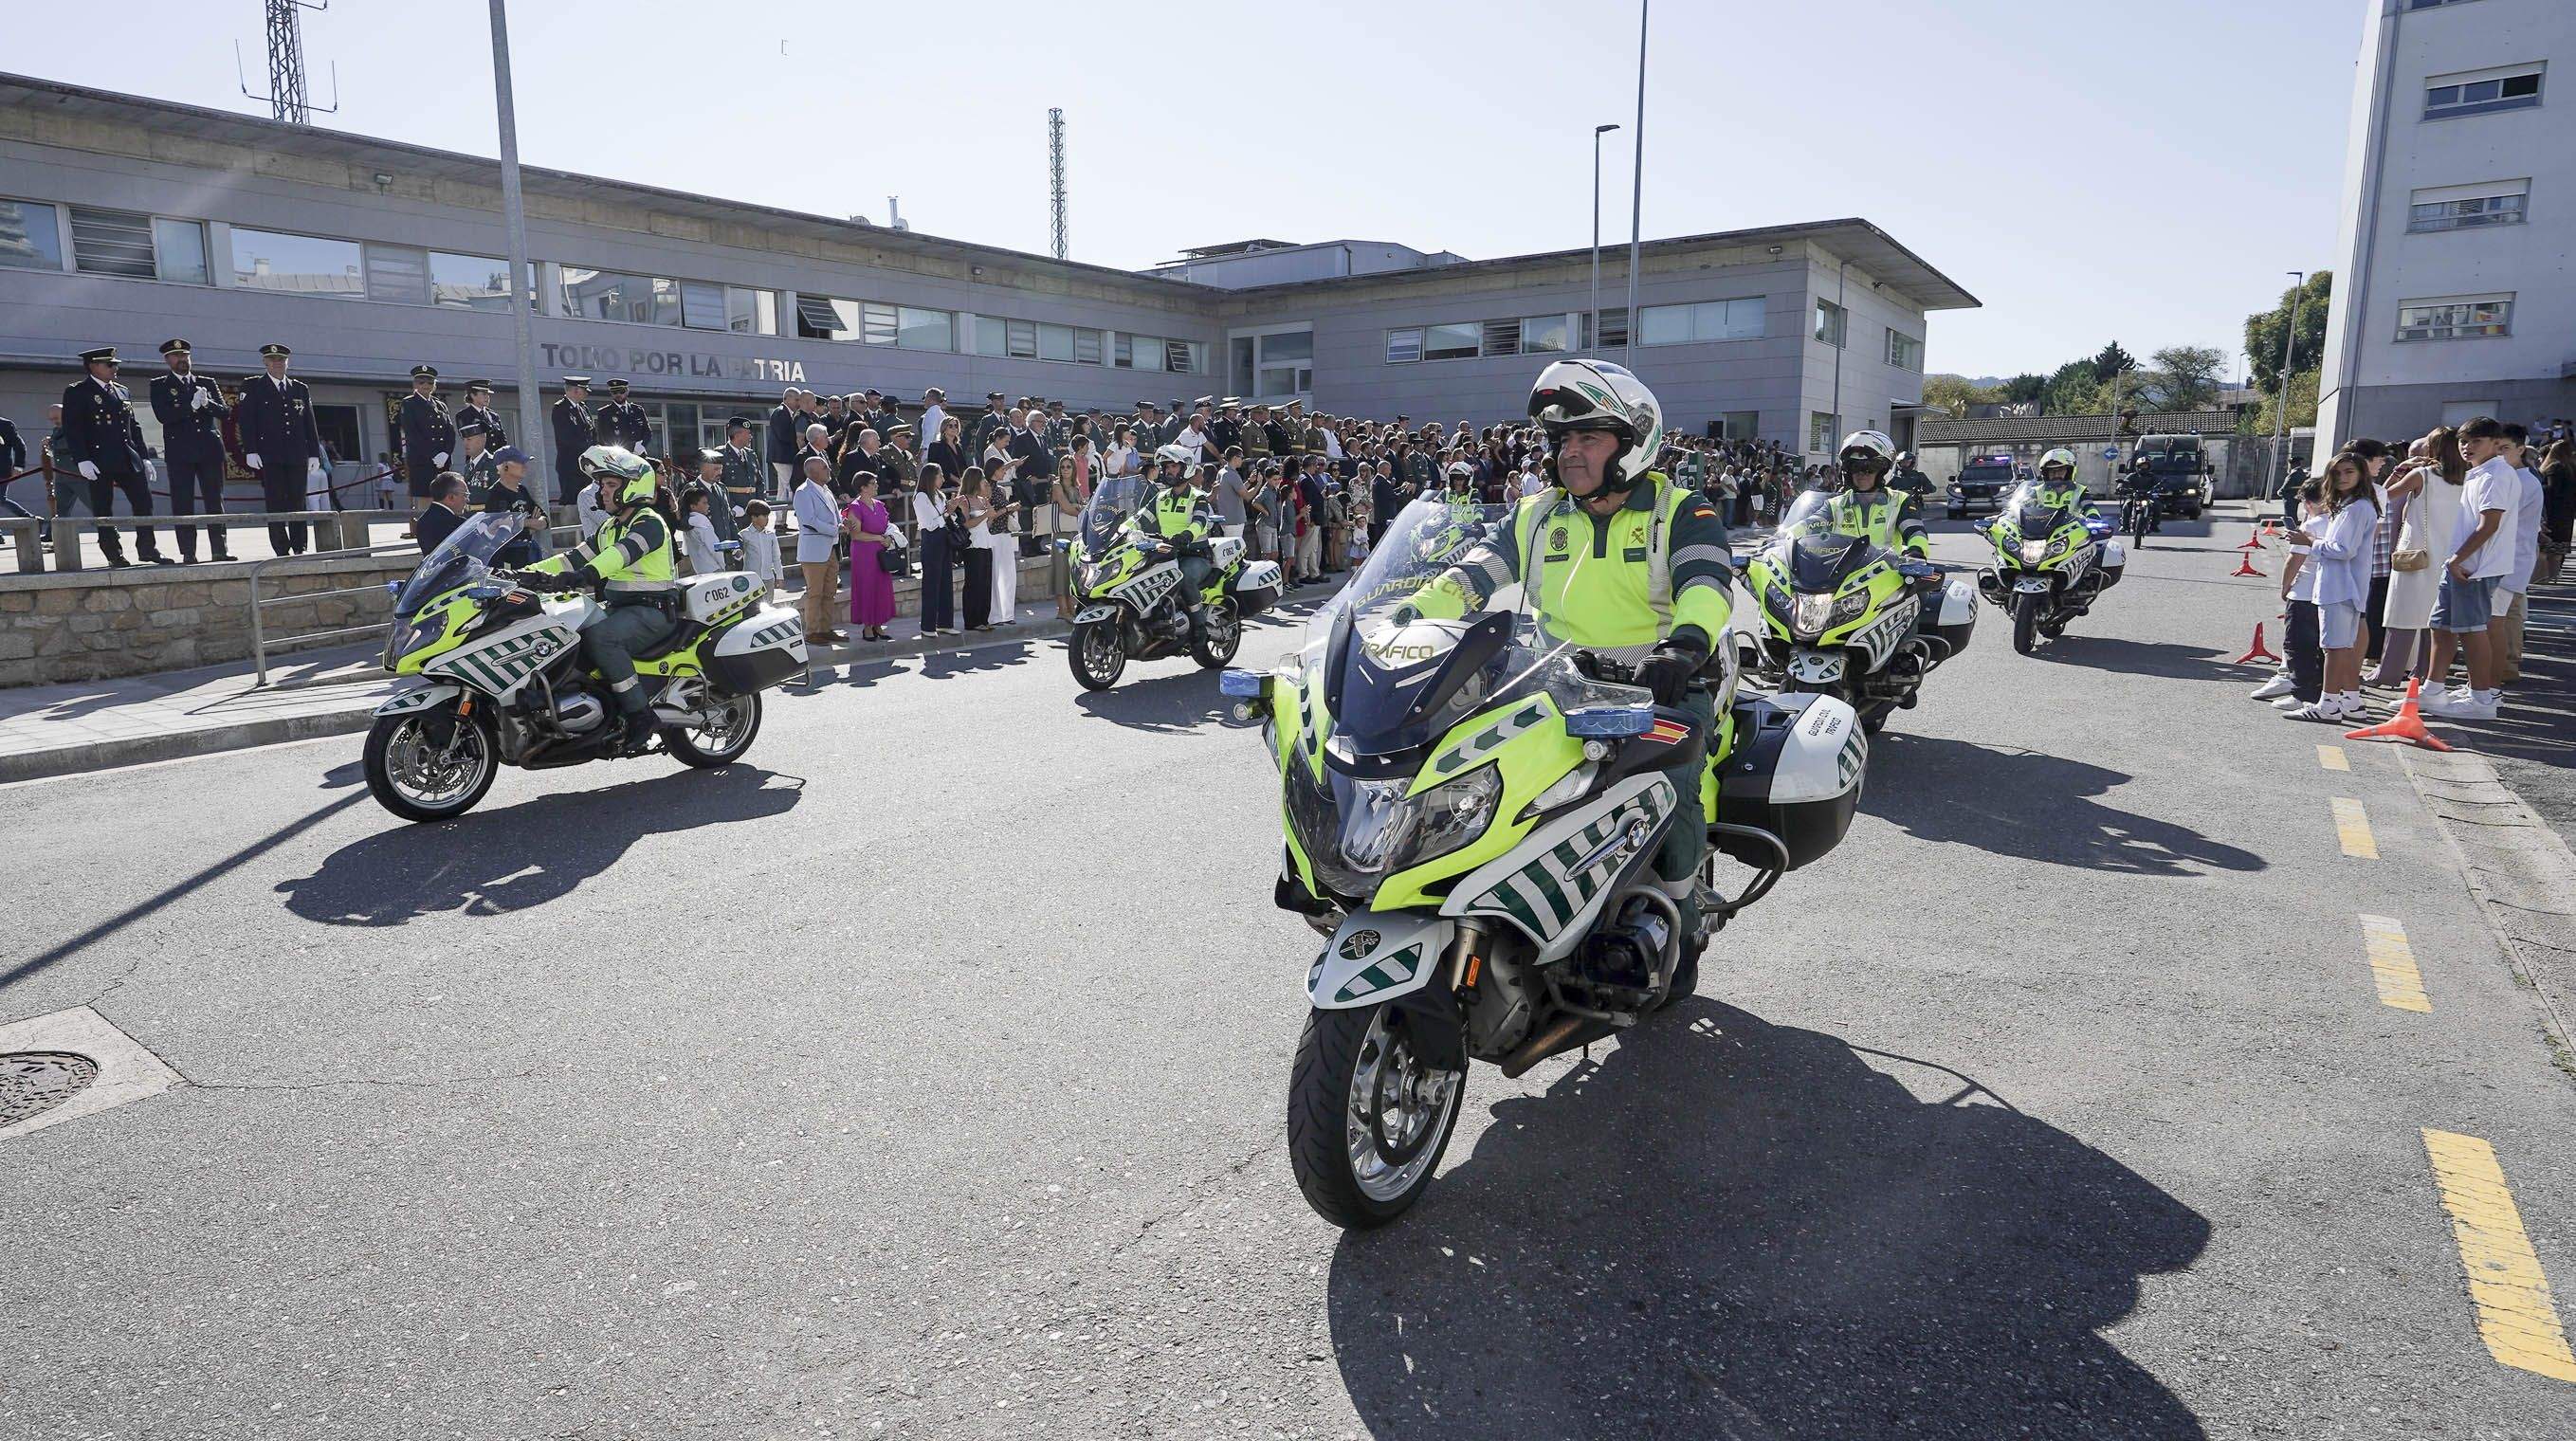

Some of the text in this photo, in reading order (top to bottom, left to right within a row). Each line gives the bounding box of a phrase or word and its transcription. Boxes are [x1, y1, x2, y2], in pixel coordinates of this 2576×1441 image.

[540, 343, 621, 371] TODO
[629, 349, 683, 375] POR
[690, 355, 721, 377] LA
[712, 587, 730, 601] 062
[1355, 575, 1434, 610] GUARDIA
[1359, 641, 1434, 660] TRAFICO
